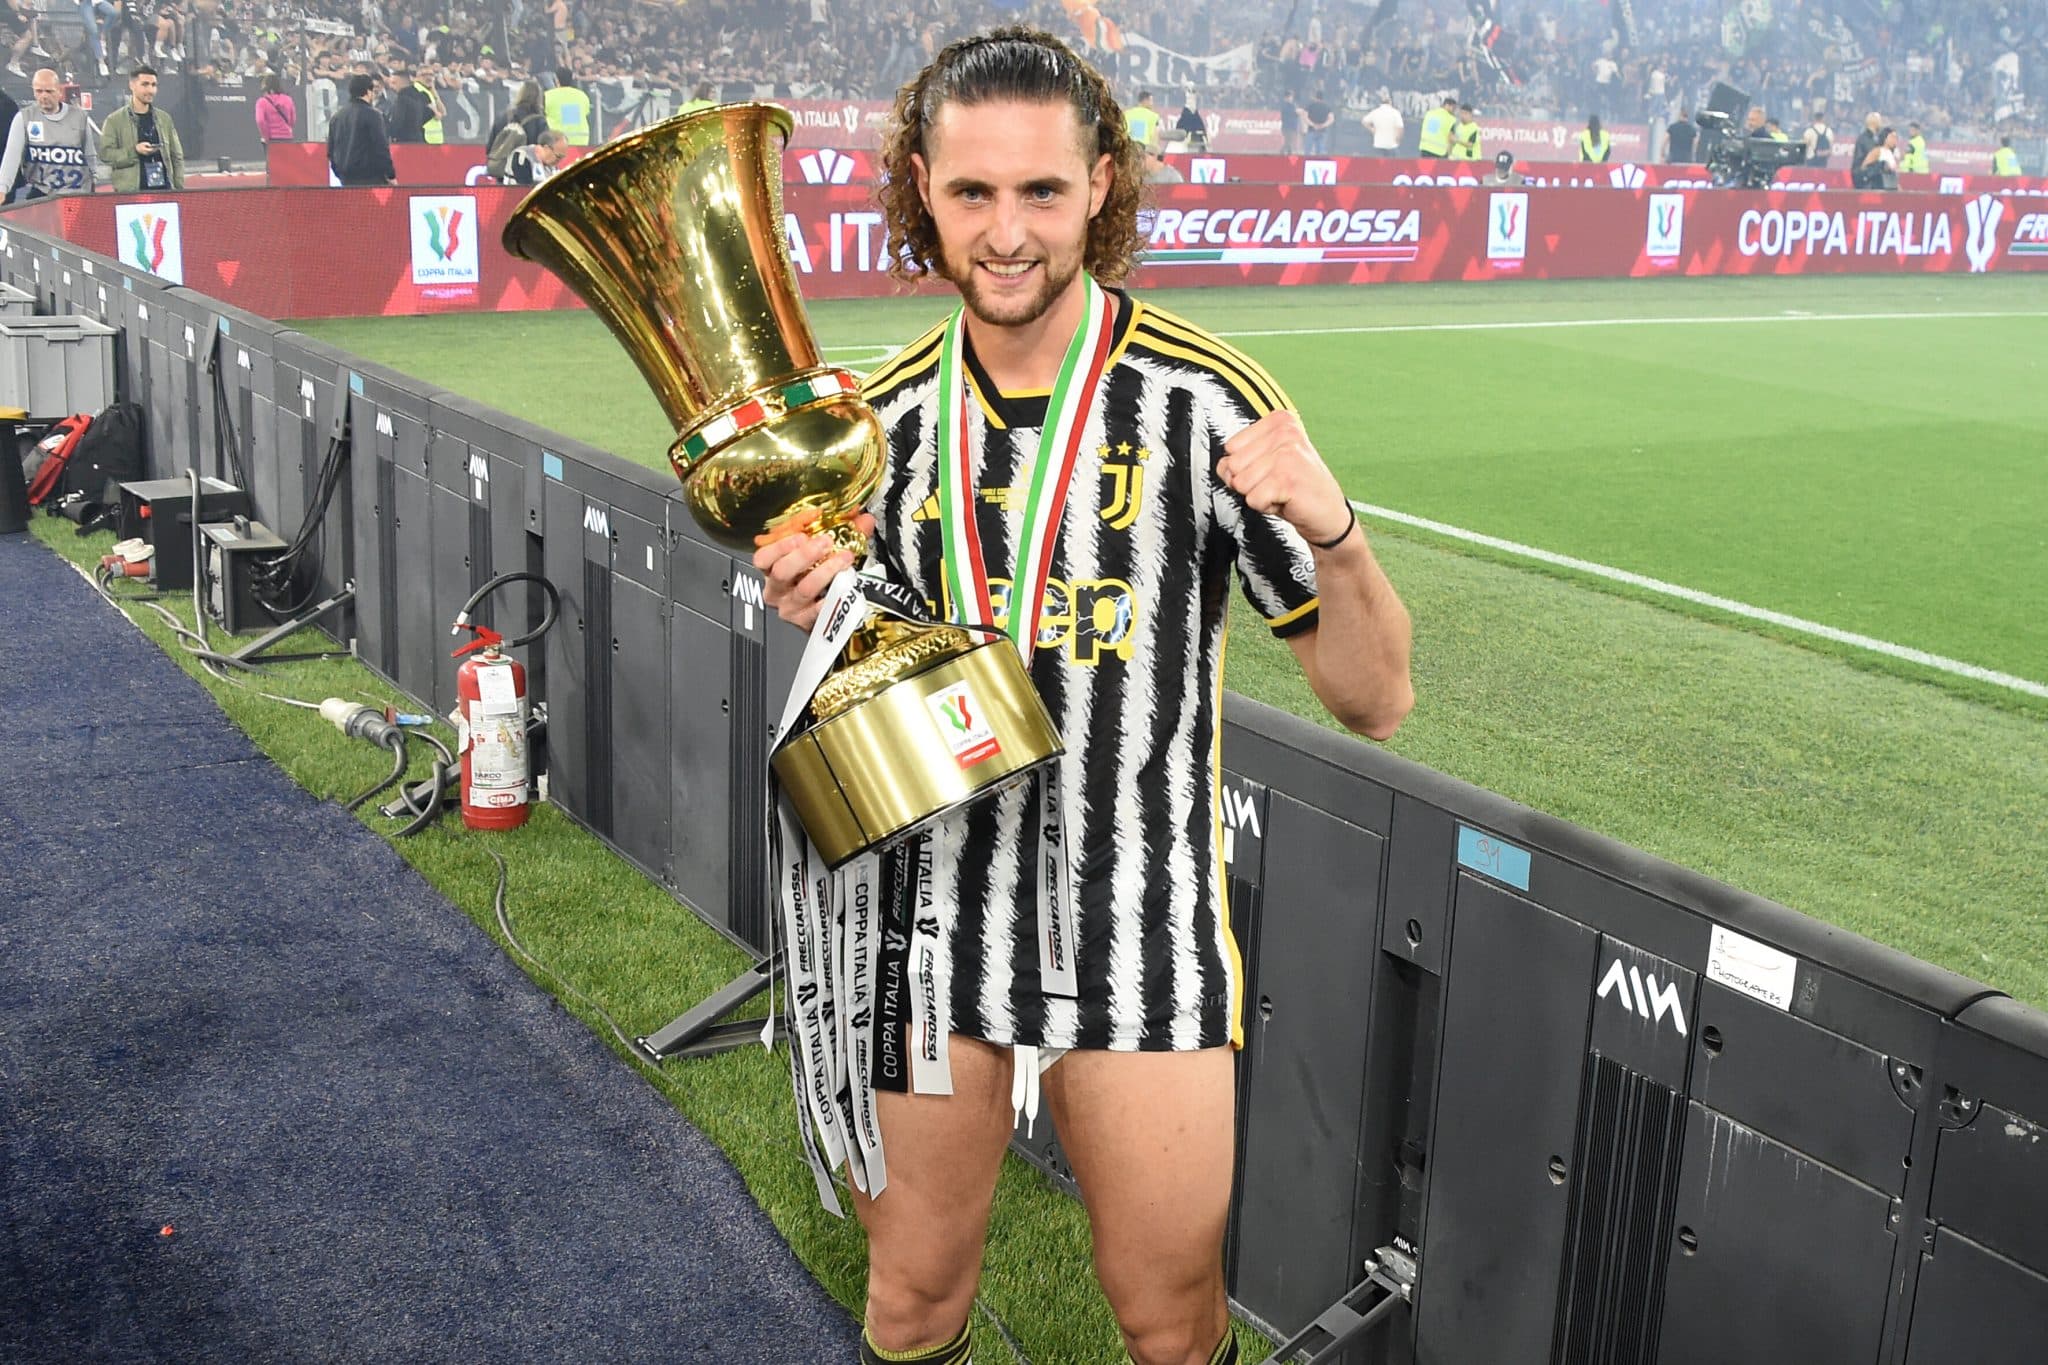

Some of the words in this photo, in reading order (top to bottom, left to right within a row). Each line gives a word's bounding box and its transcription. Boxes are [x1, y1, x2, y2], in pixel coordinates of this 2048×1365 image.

[804, 110, 840, 128] ITALIA
[1738, 210, 1848, 256] COPPA
[1856, 211, 1951, 256] ITALIA
[2014, 213, 2048, 240] FR
[892, 839, 906, 921] FRECCIAR
[918, 850, 933, 908] ITALIA
[791, 861, 809, 972] FRECCIAROSSA
[854, 882, 869, 943] COPPA
[1048, 855, 1065, 972] FRECCIAROSSA
[853, 945, 868, 1004] ITALIA
[883, 960, 900, 1018] ITALIA
[924, 949, 938, 1061] FRECCIAROSSA
[806, 1007, 823, 1065] ITALIA
[883, 1022, 898, 1078] COPPA
[814, 1066, 834, 1125] COPPA
[859, 1038, 877, 1148] FRECCIAROSSA
